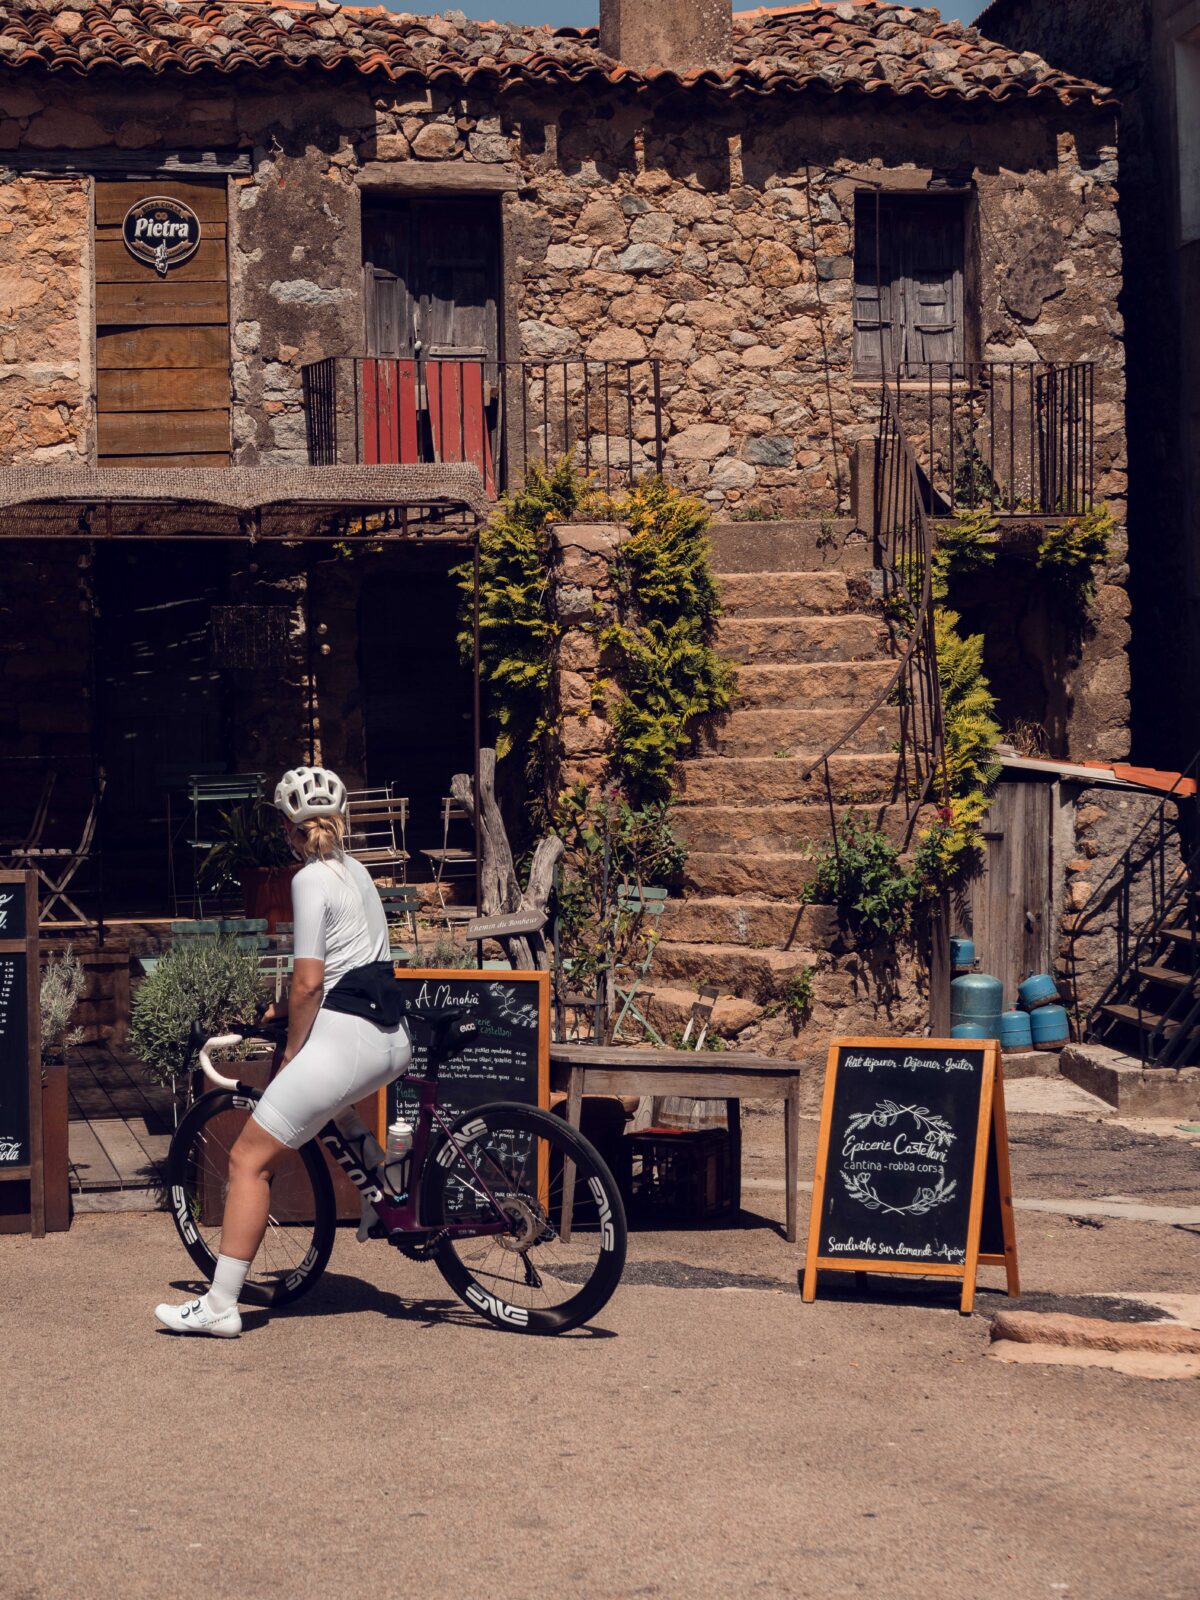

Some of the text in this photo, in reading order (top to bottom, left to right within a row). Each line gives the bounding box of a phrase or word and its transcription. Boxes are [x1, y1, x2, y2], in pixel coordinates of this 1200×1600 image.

[134, 218, 189, 237] Pietra
[470, 917, 539, 932] Chemin du Bonheur
[480, 1026, 512, 1037] castellani
[845, 1055, 863, 1067] Petit
[863, 1057, 896, 1072] déjeuner
[903, 1056, 940, 1072] Déjeuner
[404, 1100, 420, 1108] burrat
[842, 1133, 948, 1163] Epicerie Castellani
[321, 1135, 383, 1203] CTOR
[844, 1161, 882, 1171] cantina
[889, 1162, 915, 1171] robba
[917, 1164, 944, 1174] corsa
[828, 1236, 877, 1254] Sandwichs
[896, 1242, 932, 1257] demande
